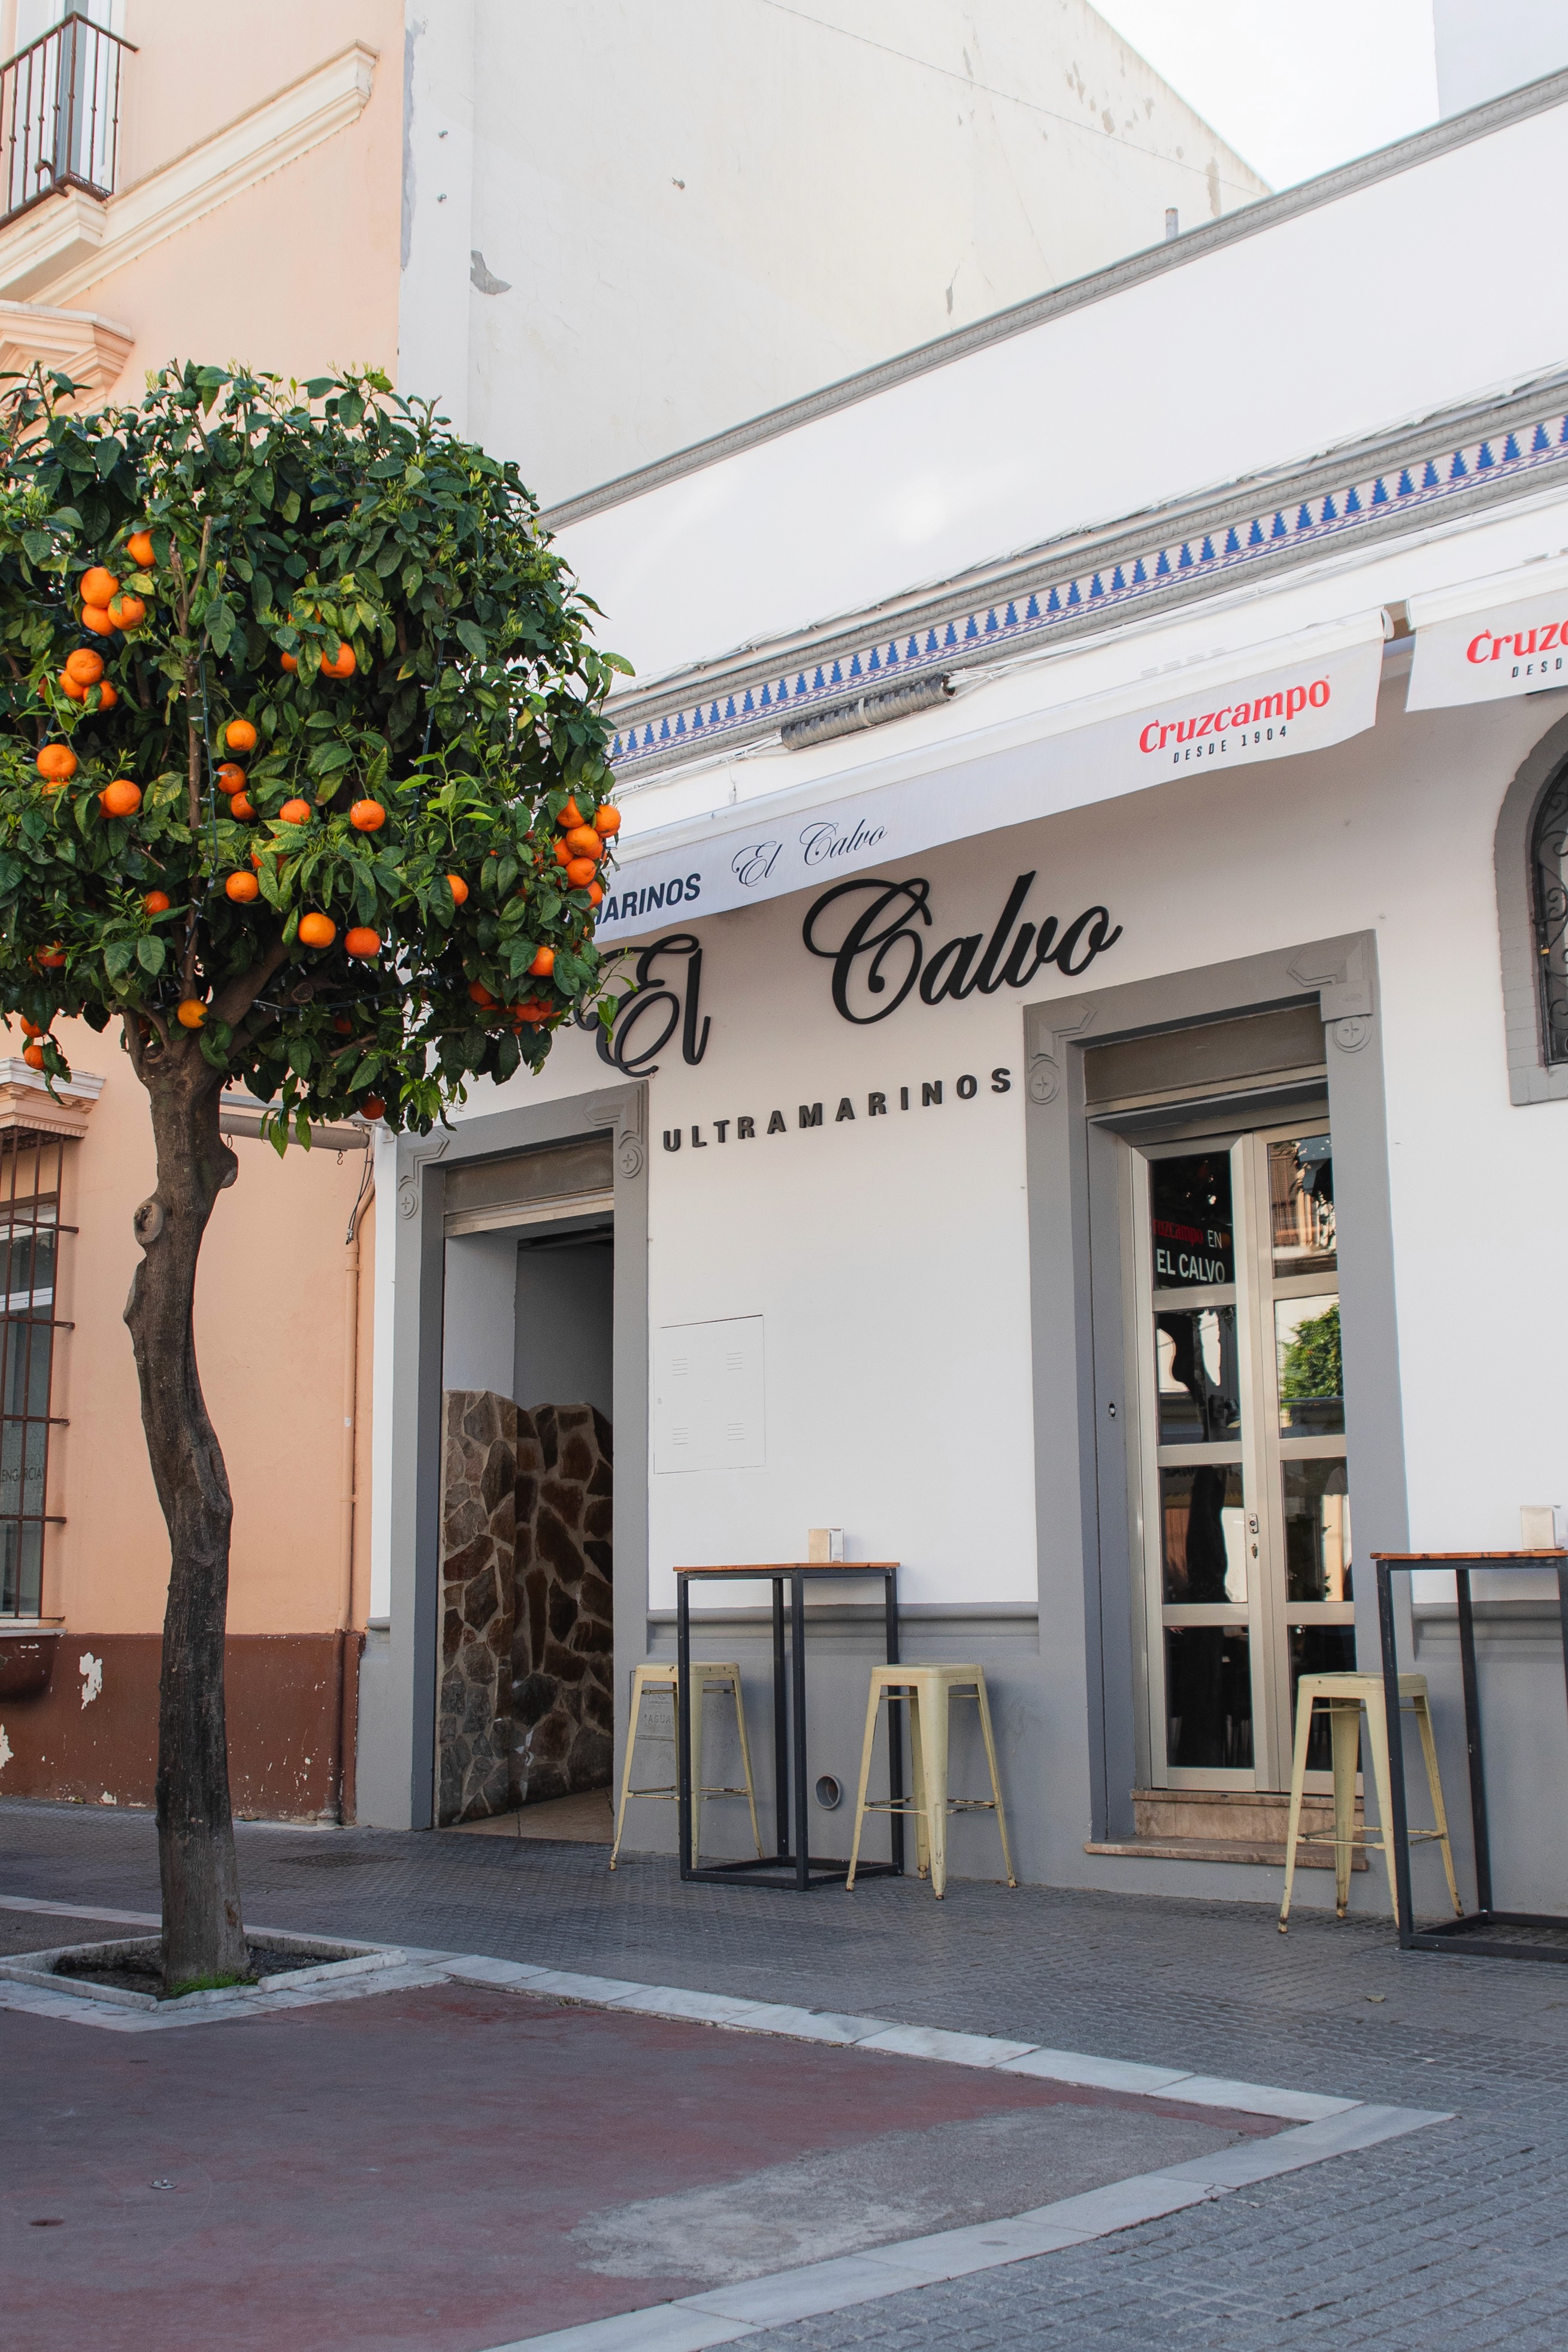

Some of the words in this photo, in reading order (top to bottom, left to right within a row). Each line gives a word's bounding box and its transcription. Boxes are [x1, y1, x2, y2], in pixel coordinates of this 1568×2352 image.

[1512, 658, 1563, 678] DESD
[1139, 679, 1331, 753] Cruzcampo
[1173, 740, 1227, 764] DESDE
[1242, 725, 1287, 747] 1904
[731, 840, 783, 888] El
[799, 818, 888, 866] Calvo
[573, 934, 711, 1077] El
[802, 870, 1124, 1025] Calvo
[662, 1067, 1012, 1152] ULTRAMARINOS
[1152, 1218, 1204, 1246] ruzcampo
[1207, 1229, 1222, 1249] EN
[1157, 1248, 1176, 1275] EL
[1179, 1253, 1225, 1284] CALVO
